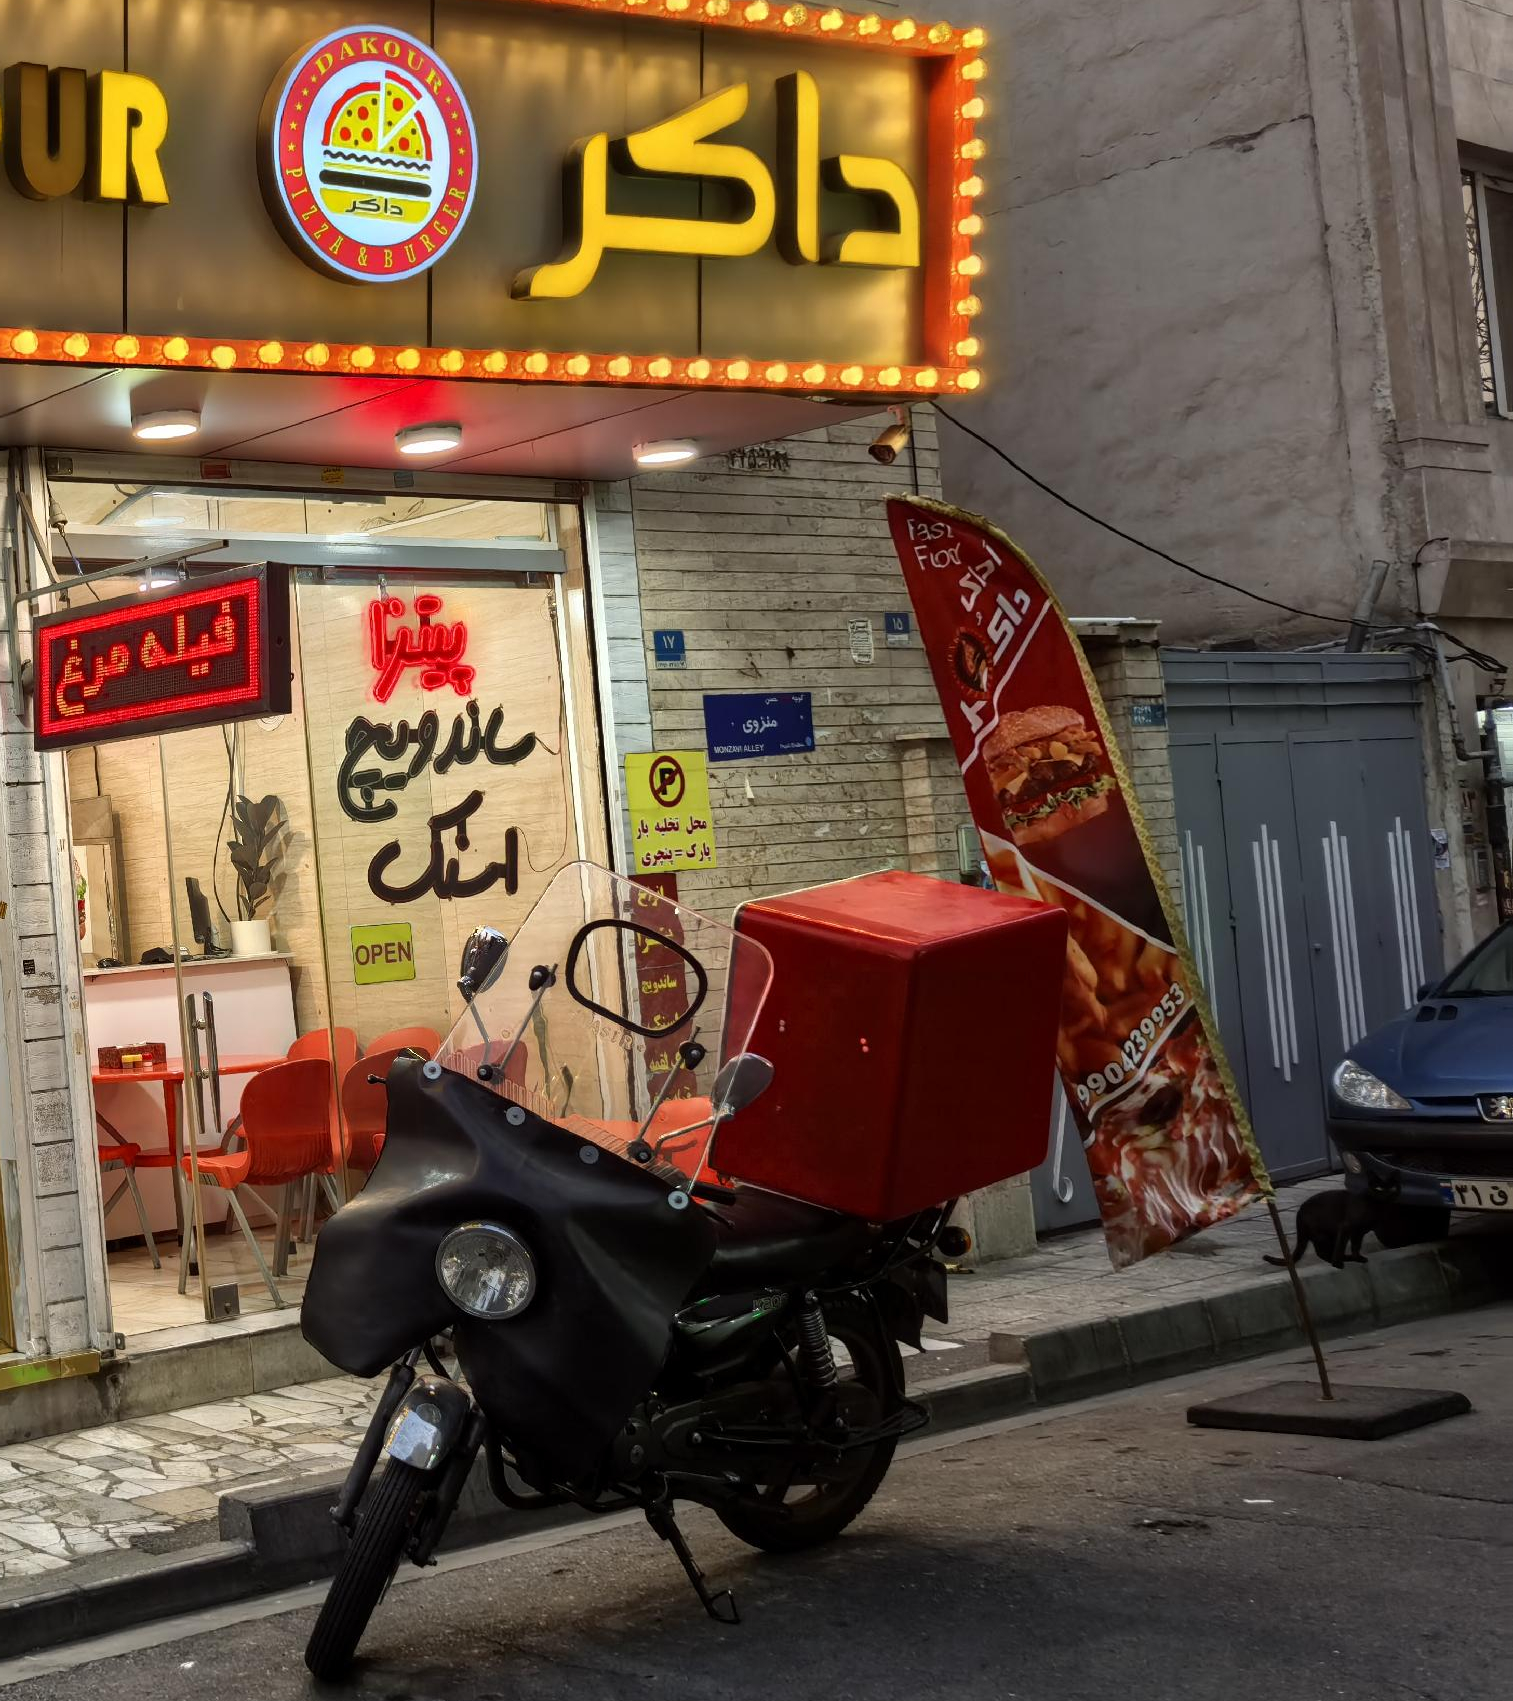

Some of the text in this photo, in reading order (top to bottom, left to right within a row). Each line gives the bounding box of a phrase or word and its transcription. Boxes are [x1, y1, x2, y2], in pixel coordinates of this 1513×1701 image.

[314, 36, 443, 97] DAKOUR
[510, 68, 920, 301] داکر
[285, 166, 467, 269] PIZZA & BURGER
[344, 197, 404, 217] داکر
[892, 617, 903, 630] ۱۵
[368, 596, 476, 703] پیتزا
[662, 635, 675, 649] ۱۷
[56, 600, 235, 718] فیله مرغ
[742, 715, 778, 734] منزوی
[743, 744, 765, 753] ALLEY
[337, 700, 536, 823] ساندویچ
[636, 815, 707, 840] محل تخلیه بار
[367, 790, 519, 904] اسنک
[641, 847, 674, 867] پنچری
[686, 842, 712, 862] پارک
[355, 941, 412, 966] OPEN
[641, 974, 677, 994] ساندویچ
[1454, 1184, 1508, 1206] ۳۱ ق
